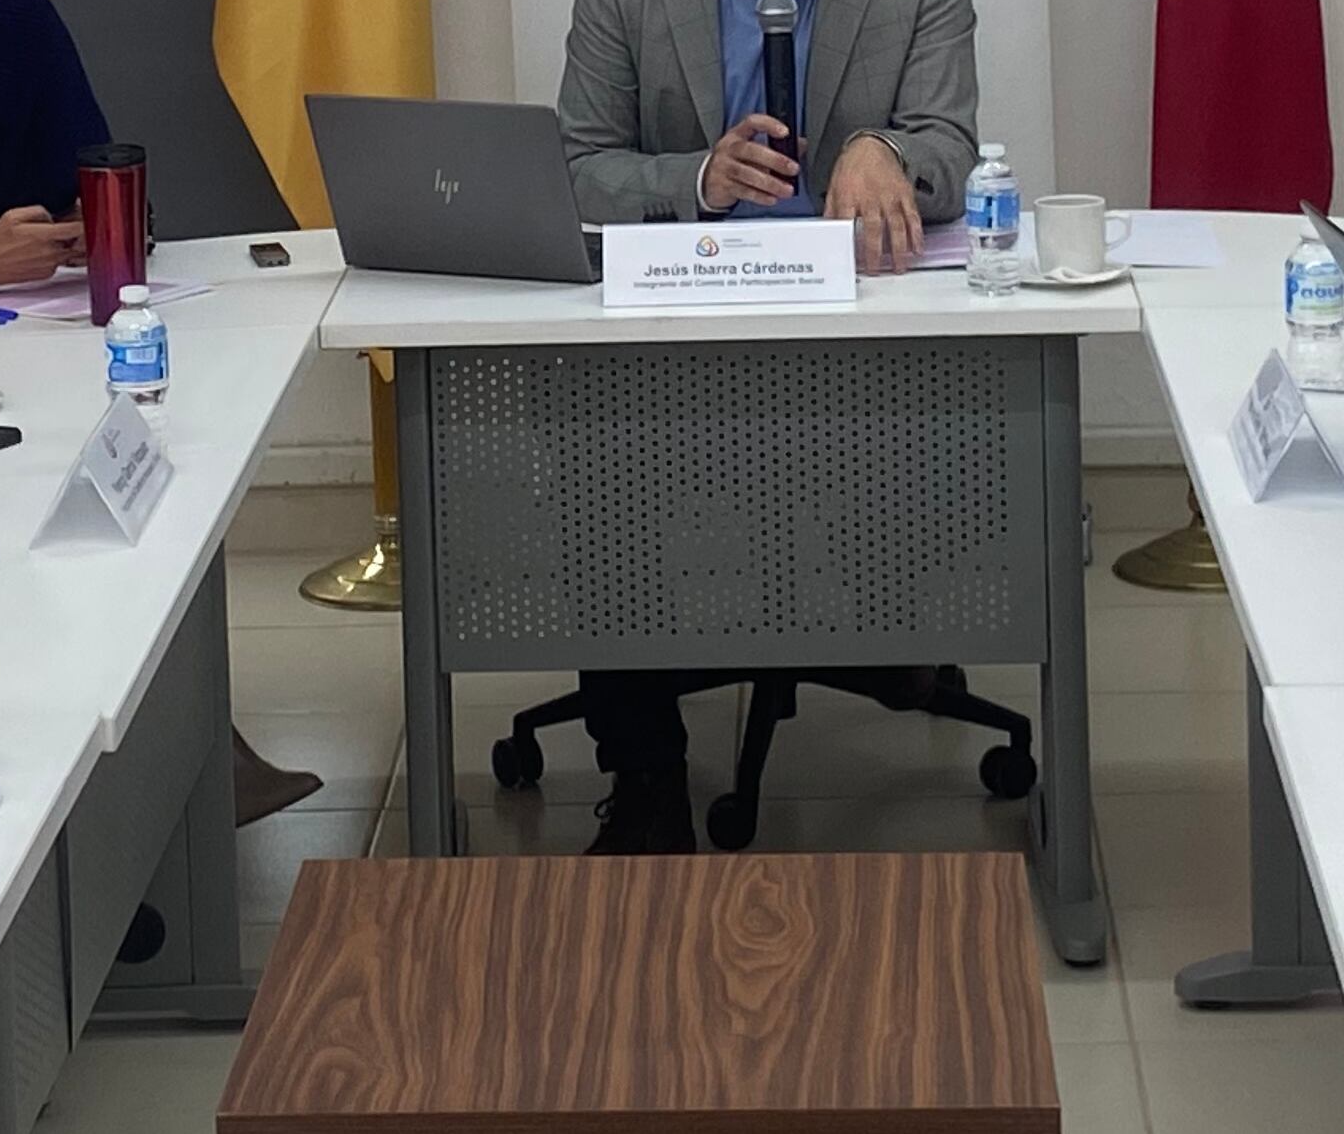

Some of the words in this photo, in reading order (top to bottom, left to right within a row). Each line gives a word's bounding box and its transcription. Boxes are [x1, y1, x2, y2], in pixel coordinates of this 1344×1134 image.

[644, 263, 689, 277] Jesús
[694, 263, 737, 276] Ibarra
[741, 261, 814, 275] Cárdenas
